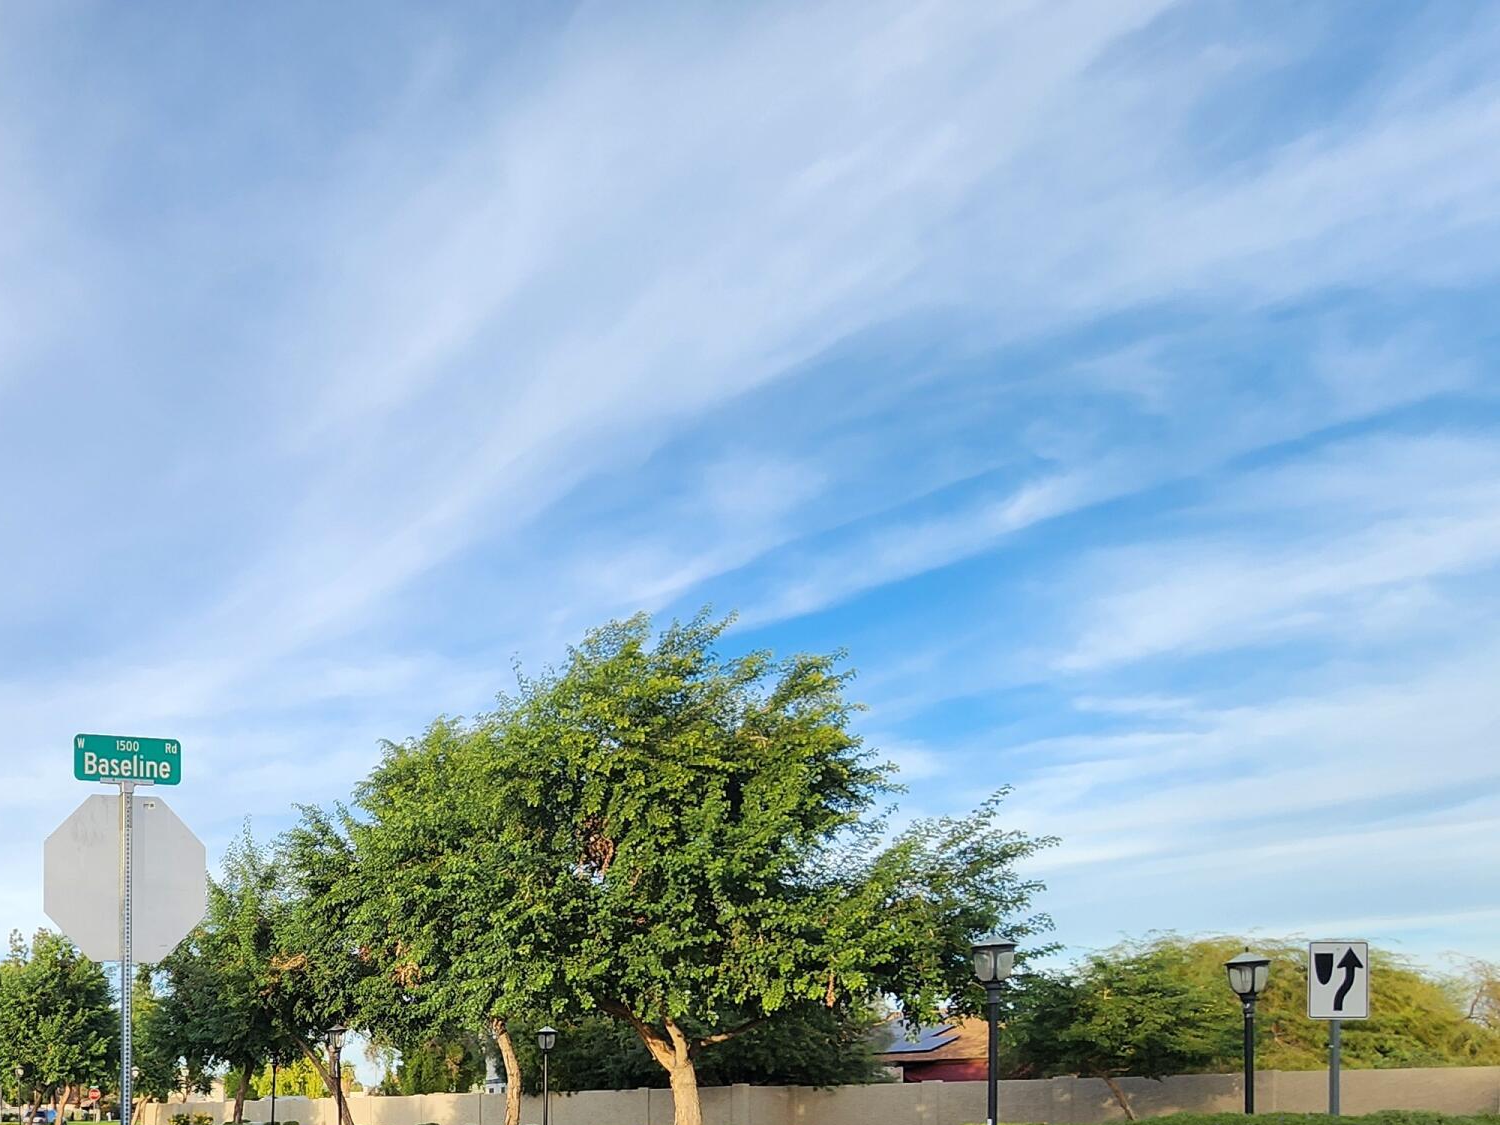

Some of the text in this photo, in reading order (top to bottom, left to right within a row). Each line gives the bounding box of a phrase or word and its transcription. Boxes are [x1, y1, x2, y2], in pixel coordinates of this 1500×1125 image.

[77, 737, 178, 754] W 1500 Rd
[84, 751, 171, 779] Baseline
